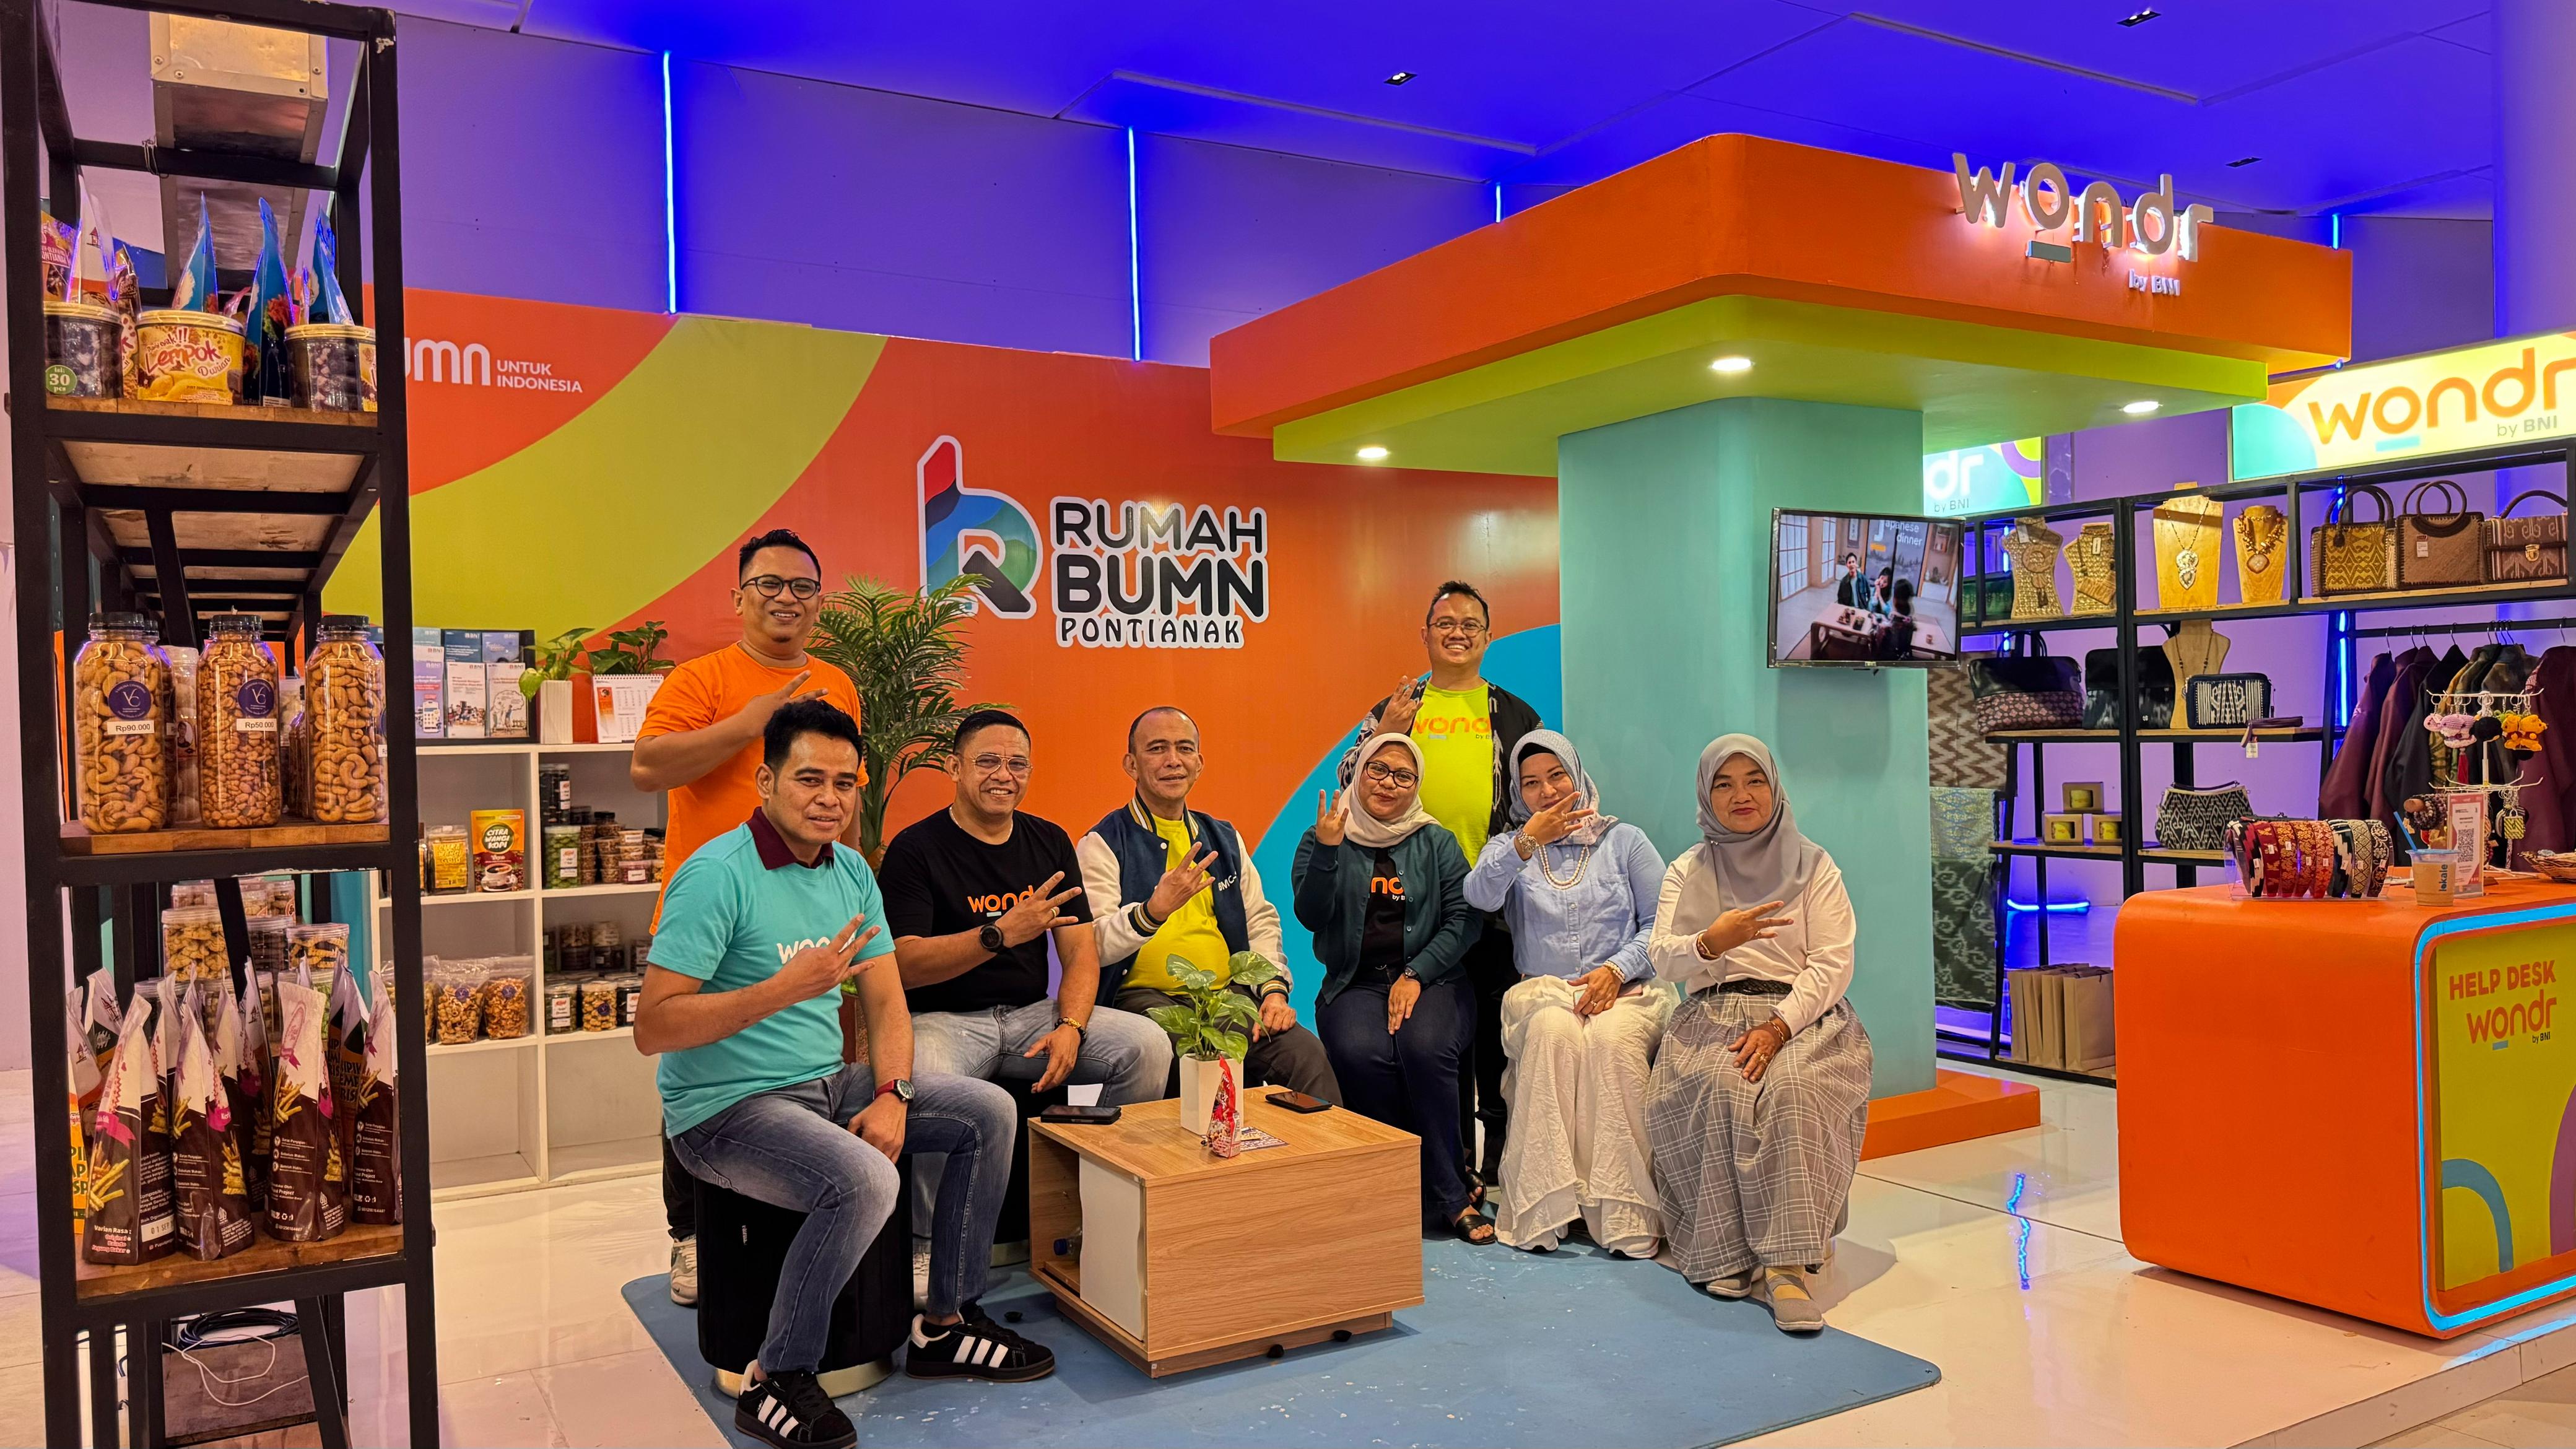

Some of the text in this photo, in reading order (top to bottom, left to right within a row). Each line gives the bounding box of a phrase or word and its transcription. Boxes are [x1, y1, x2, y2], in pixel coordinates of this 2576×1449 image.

[1953, 153, 2214, 262] wondr
[2129, 269, 2180, 296] by BNI
[50, 373, 70, 385] 30
[497, 360, 552, 375] UNTUK
[497, 375, 583, 393] INDONESIA
[2308, 347, 2576, 445] wondr
[2497, 415, 2558, 438] by BNI
[1934, 498, 1969, 513] by BNI
[1055, 501, 1264, 554] RUMAH
[1897, 533, 1923, 546] dinner
[1056, 554, 1264, 617] BUMN
[1061, 617, 1240, 644] PONTIANAK
[116, 724, 150, 733] Rp90.000
[2439, 864, 2448, 892] lokale
[967, 885, 1034, 913] wond
[2449, 960, 2557, 1001] HELP DESK
[2466, 989, 2557, 1045] wondr
[2532, 1032, 2551, 1044] by BNI
[94, 1225, 112, 1233] Varian
